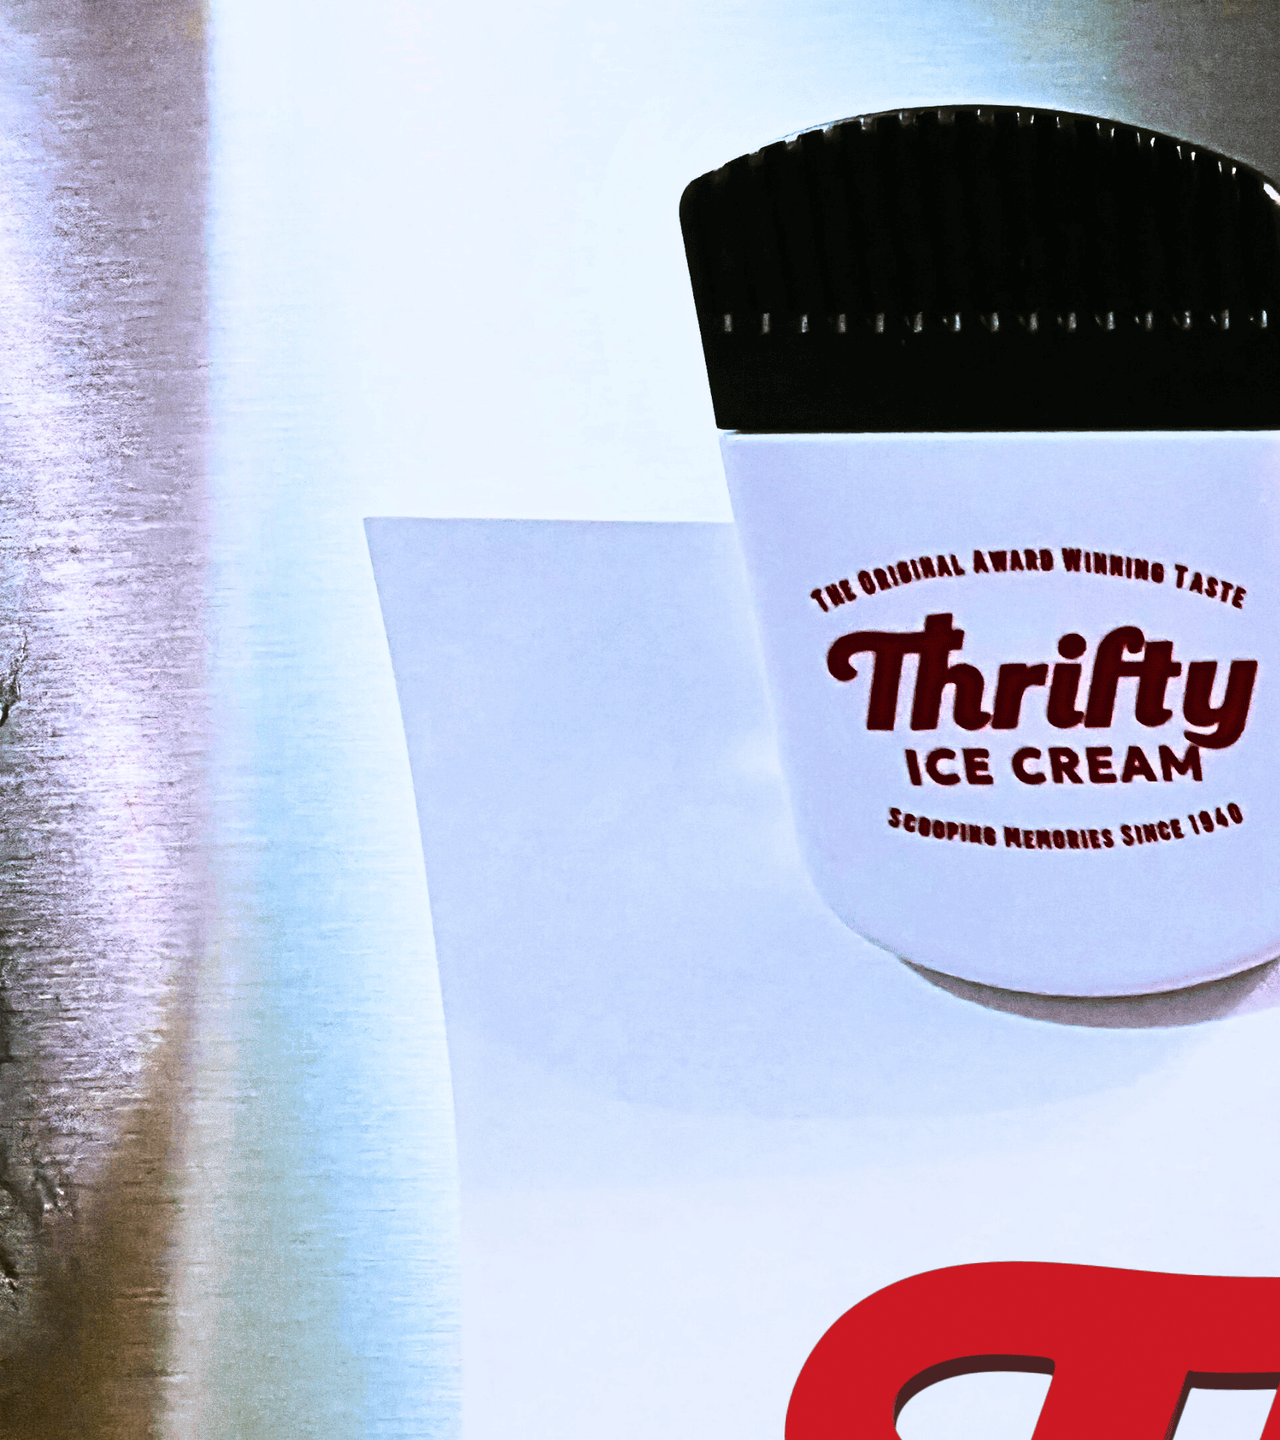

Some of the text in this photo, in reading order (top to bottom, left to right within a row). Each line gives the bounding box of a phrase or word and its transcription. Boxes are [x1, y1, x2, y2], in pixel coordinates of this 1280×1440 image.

[826, 612, 1258, 749] Thrifty
[904, 744, 1203, 786] ICE CREAM
[1189, 802, 1244, 835] 1940
